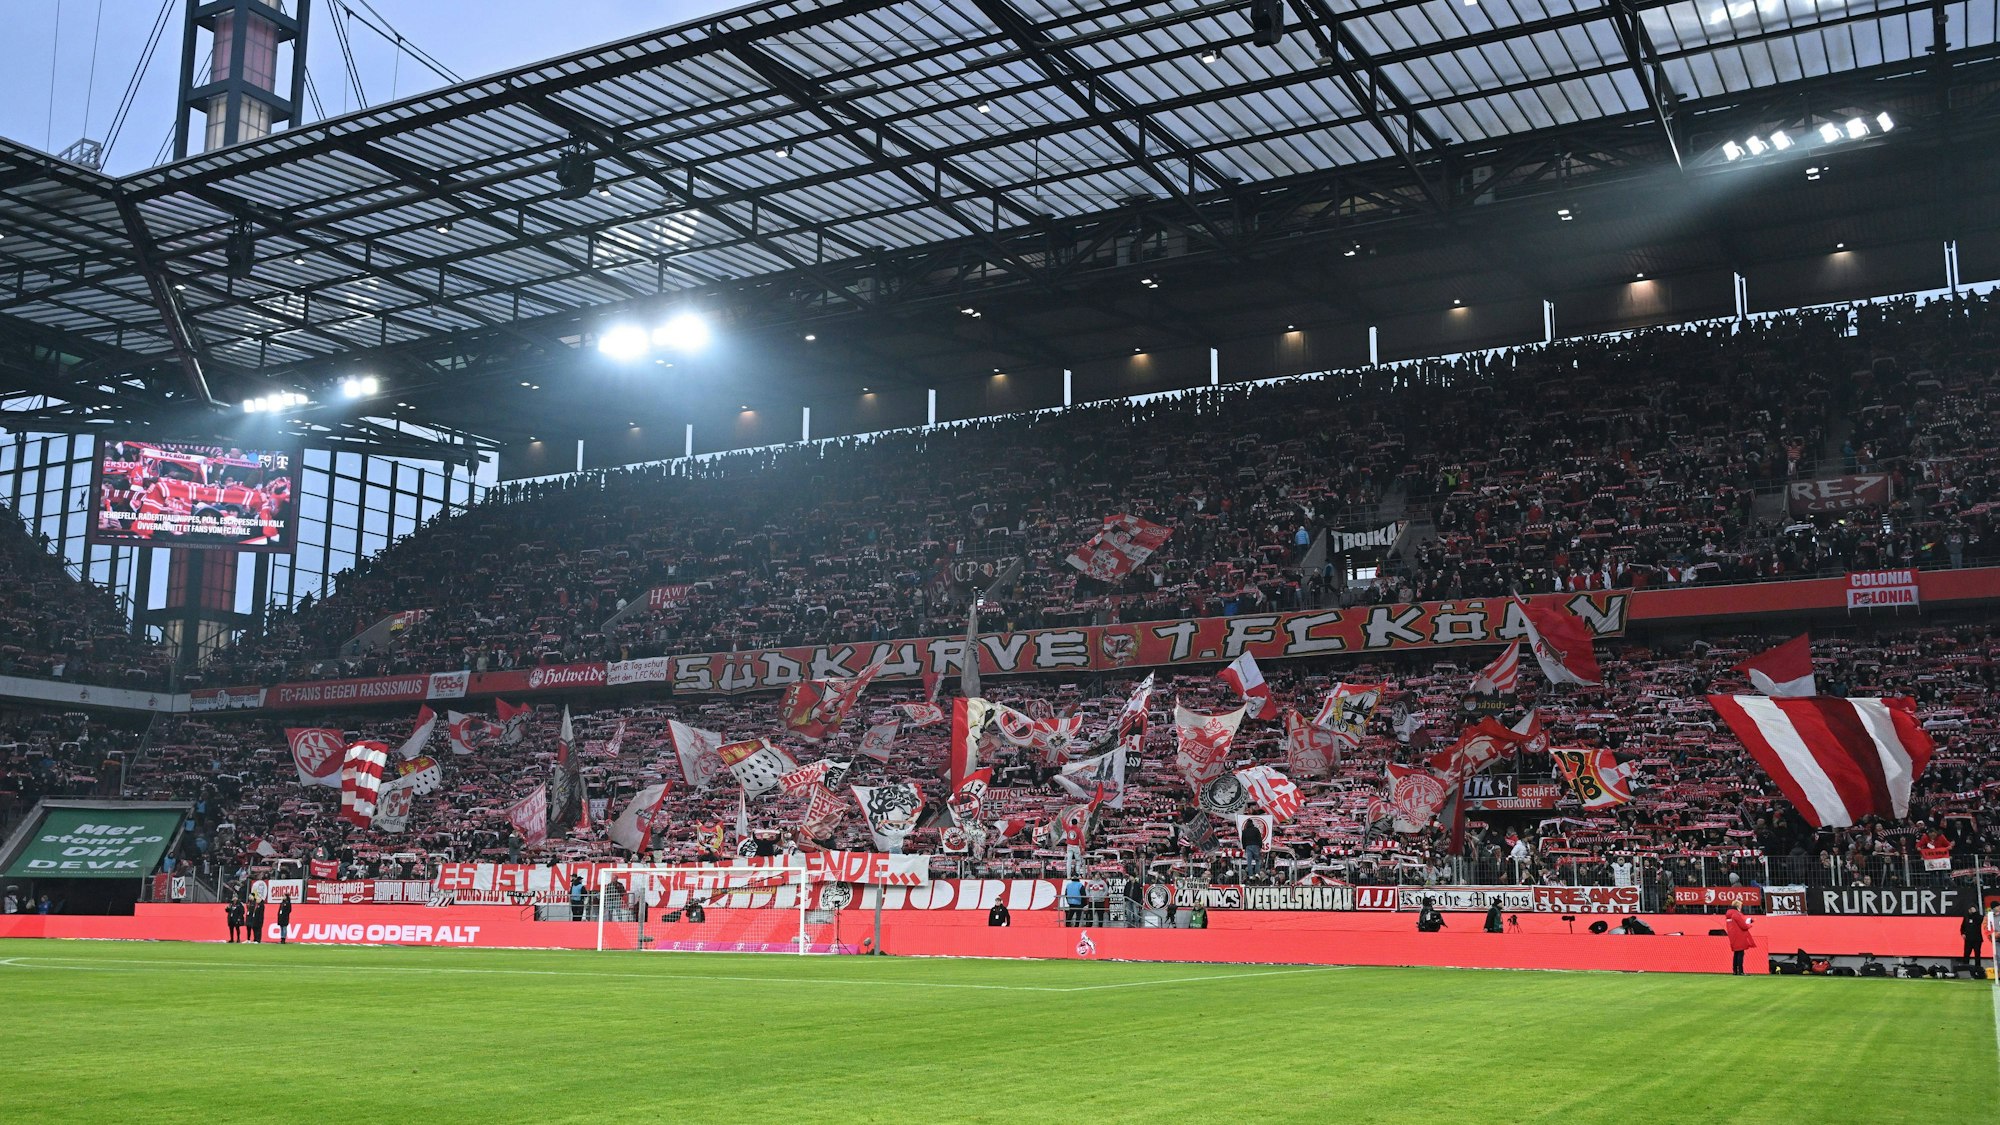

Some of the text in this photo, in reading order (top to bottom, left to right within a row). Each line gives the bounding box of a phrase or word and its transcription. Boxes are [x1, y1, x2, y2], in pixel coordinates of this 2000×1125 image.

[1790, 475, 1885, 500] RE7
[1807, 497, 1866, 511] CREW
[1851, 570, 1913, 587] COLONIA
[543, 665, 606, 687] Holweide
[280, 686, 321, 702] FC-FANS
[324, 683, 358, 700] GEGEN
[359, 679, 423, 698] RASSISMUS
[1521, 785, 1561, 797] SCHÄFER
[73, 823, 145, 836] Mer
[40, 834, 164, 845] stonn zo
[61, 846, 135, 857] Dir!
[27, 859, 142, 869] DEVK
[438, 863, 478, 890] ES
[490, 863, 536, 892] IST
[1358, 889, 1394, 908] AJJ
[1533, 886, 1640, 905] FREAKS
[1675, 891, 1759, 902] RED GOATS
[1771, 895, 1795, 911] FC
[1822, 889, 1958, 914] RURDORF
[1535, 904, 1638, 913] COLOGNE
[303, 923, 365, 941] JUNG
[366, 924, 434, 943] ODER
[433, 925, 481, 943] ALT
